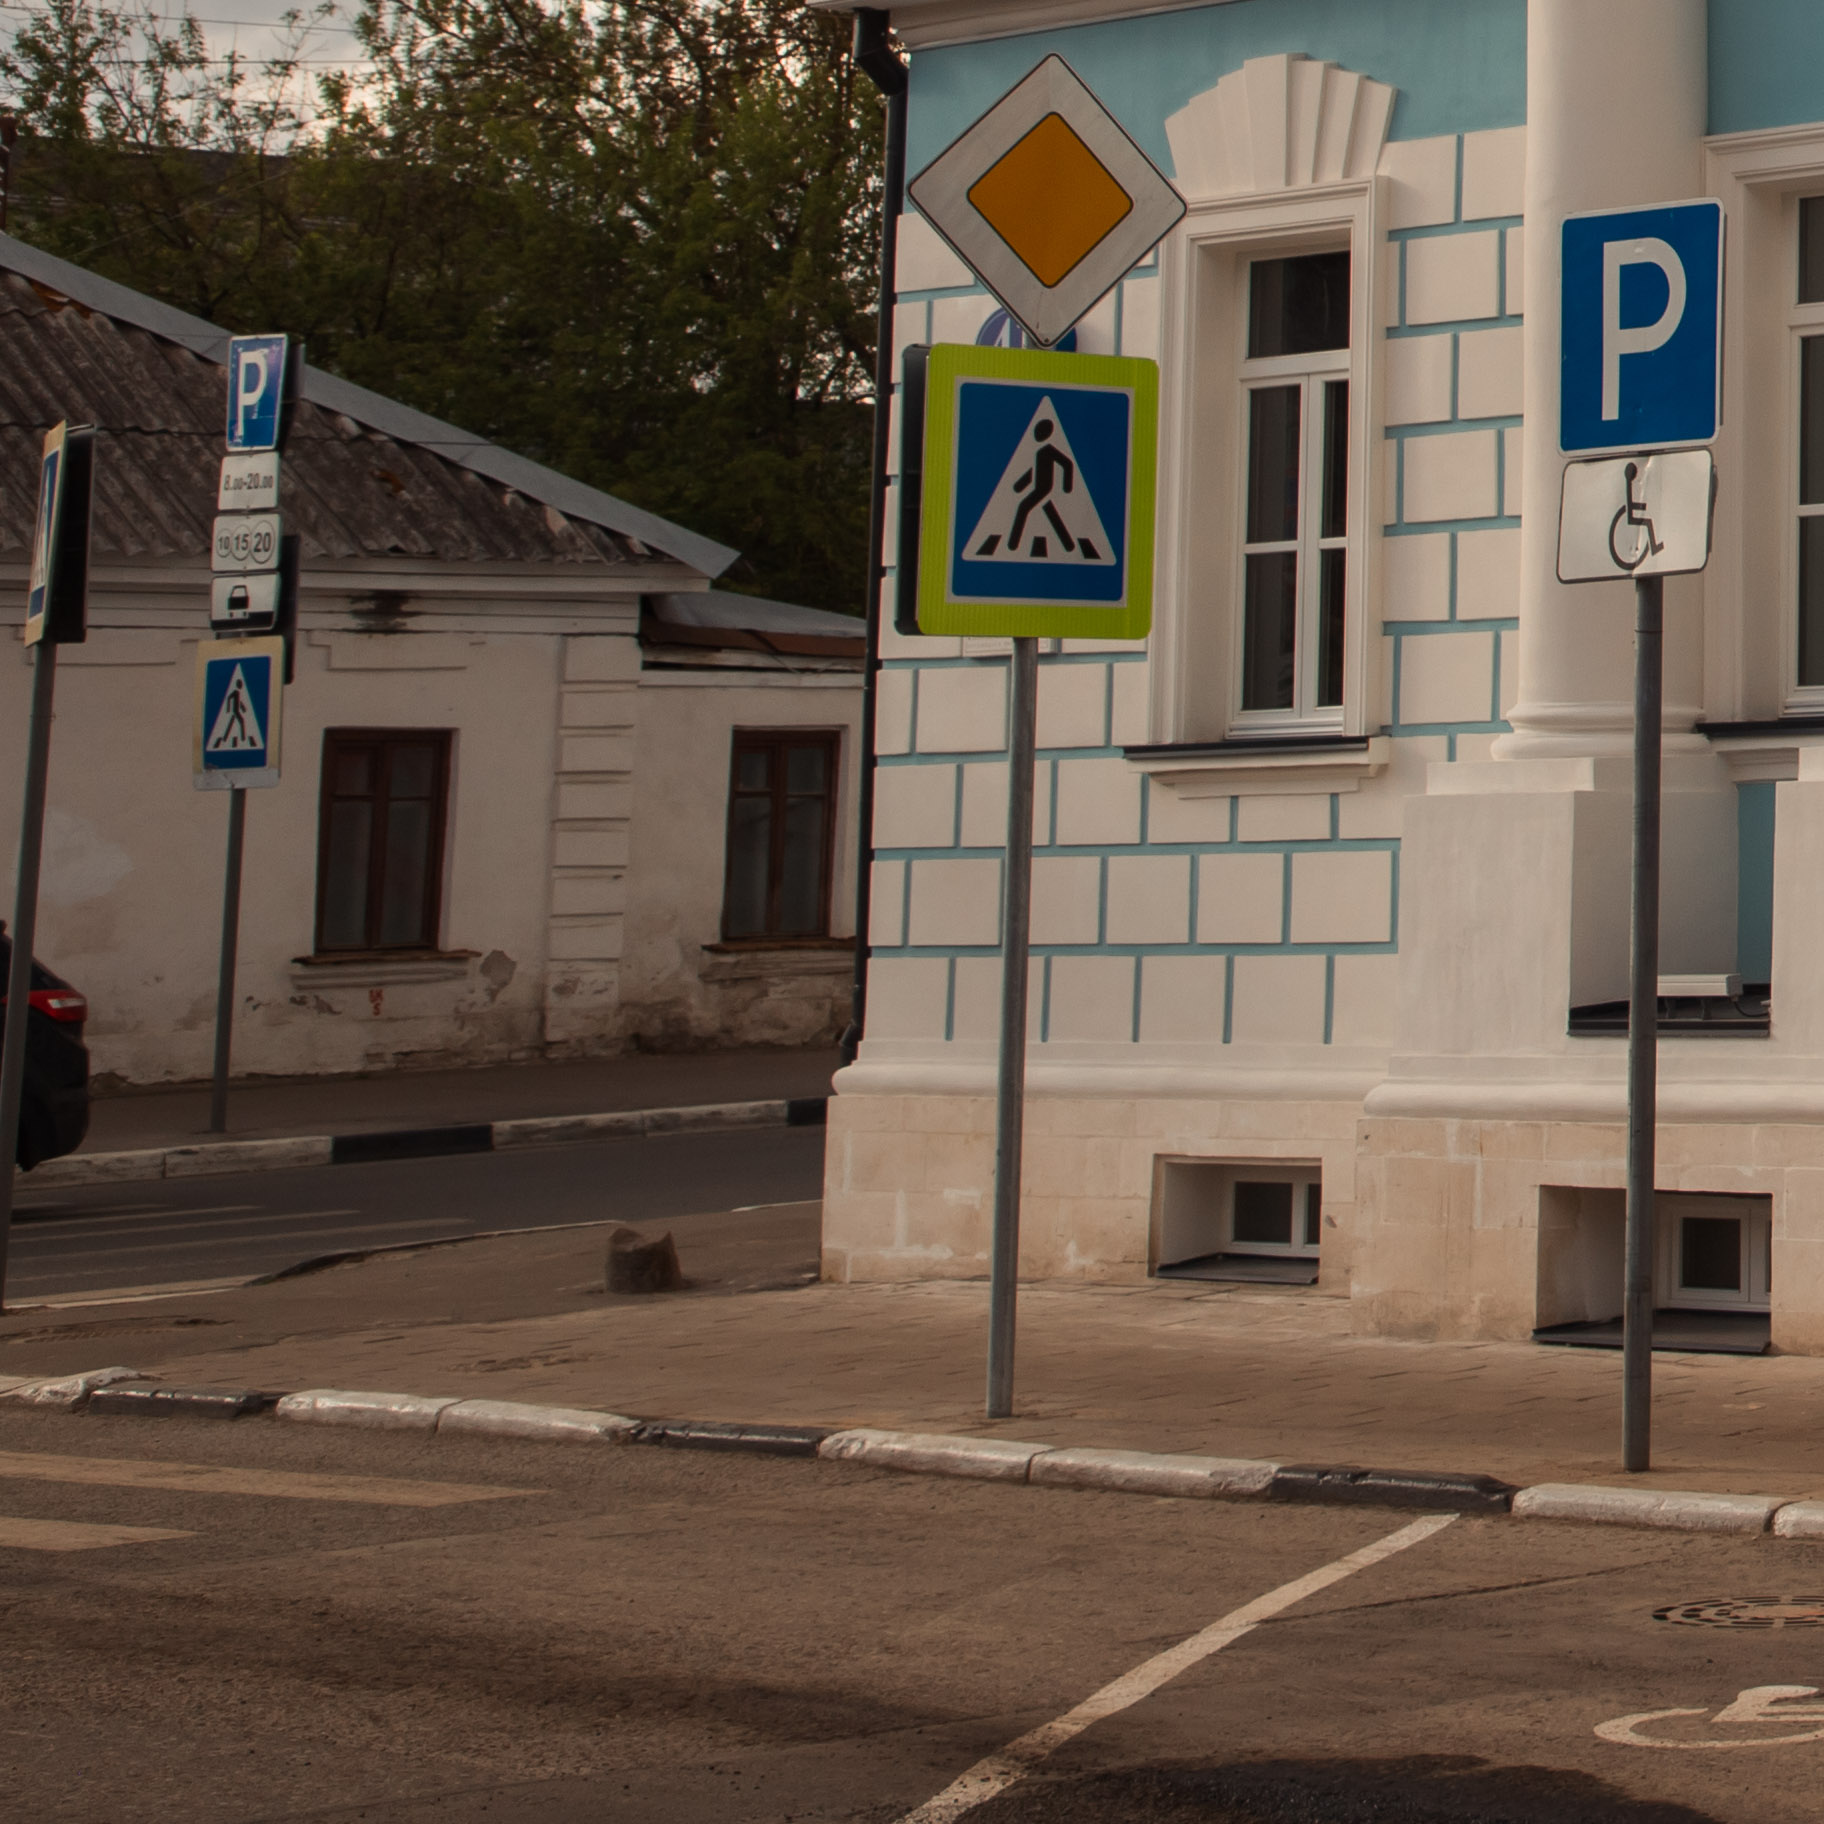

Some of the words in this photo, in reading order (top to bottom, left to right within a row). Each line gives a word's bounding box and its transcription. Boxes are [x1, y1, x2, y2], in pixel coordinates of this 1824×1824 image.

[1602, 237, 1687, 421] P
[238, 349, 268, 437] P
[218, 536, 229, 550] 10
[234, 534, 249, 551] 15
[254, 532, 271, 552] 20
